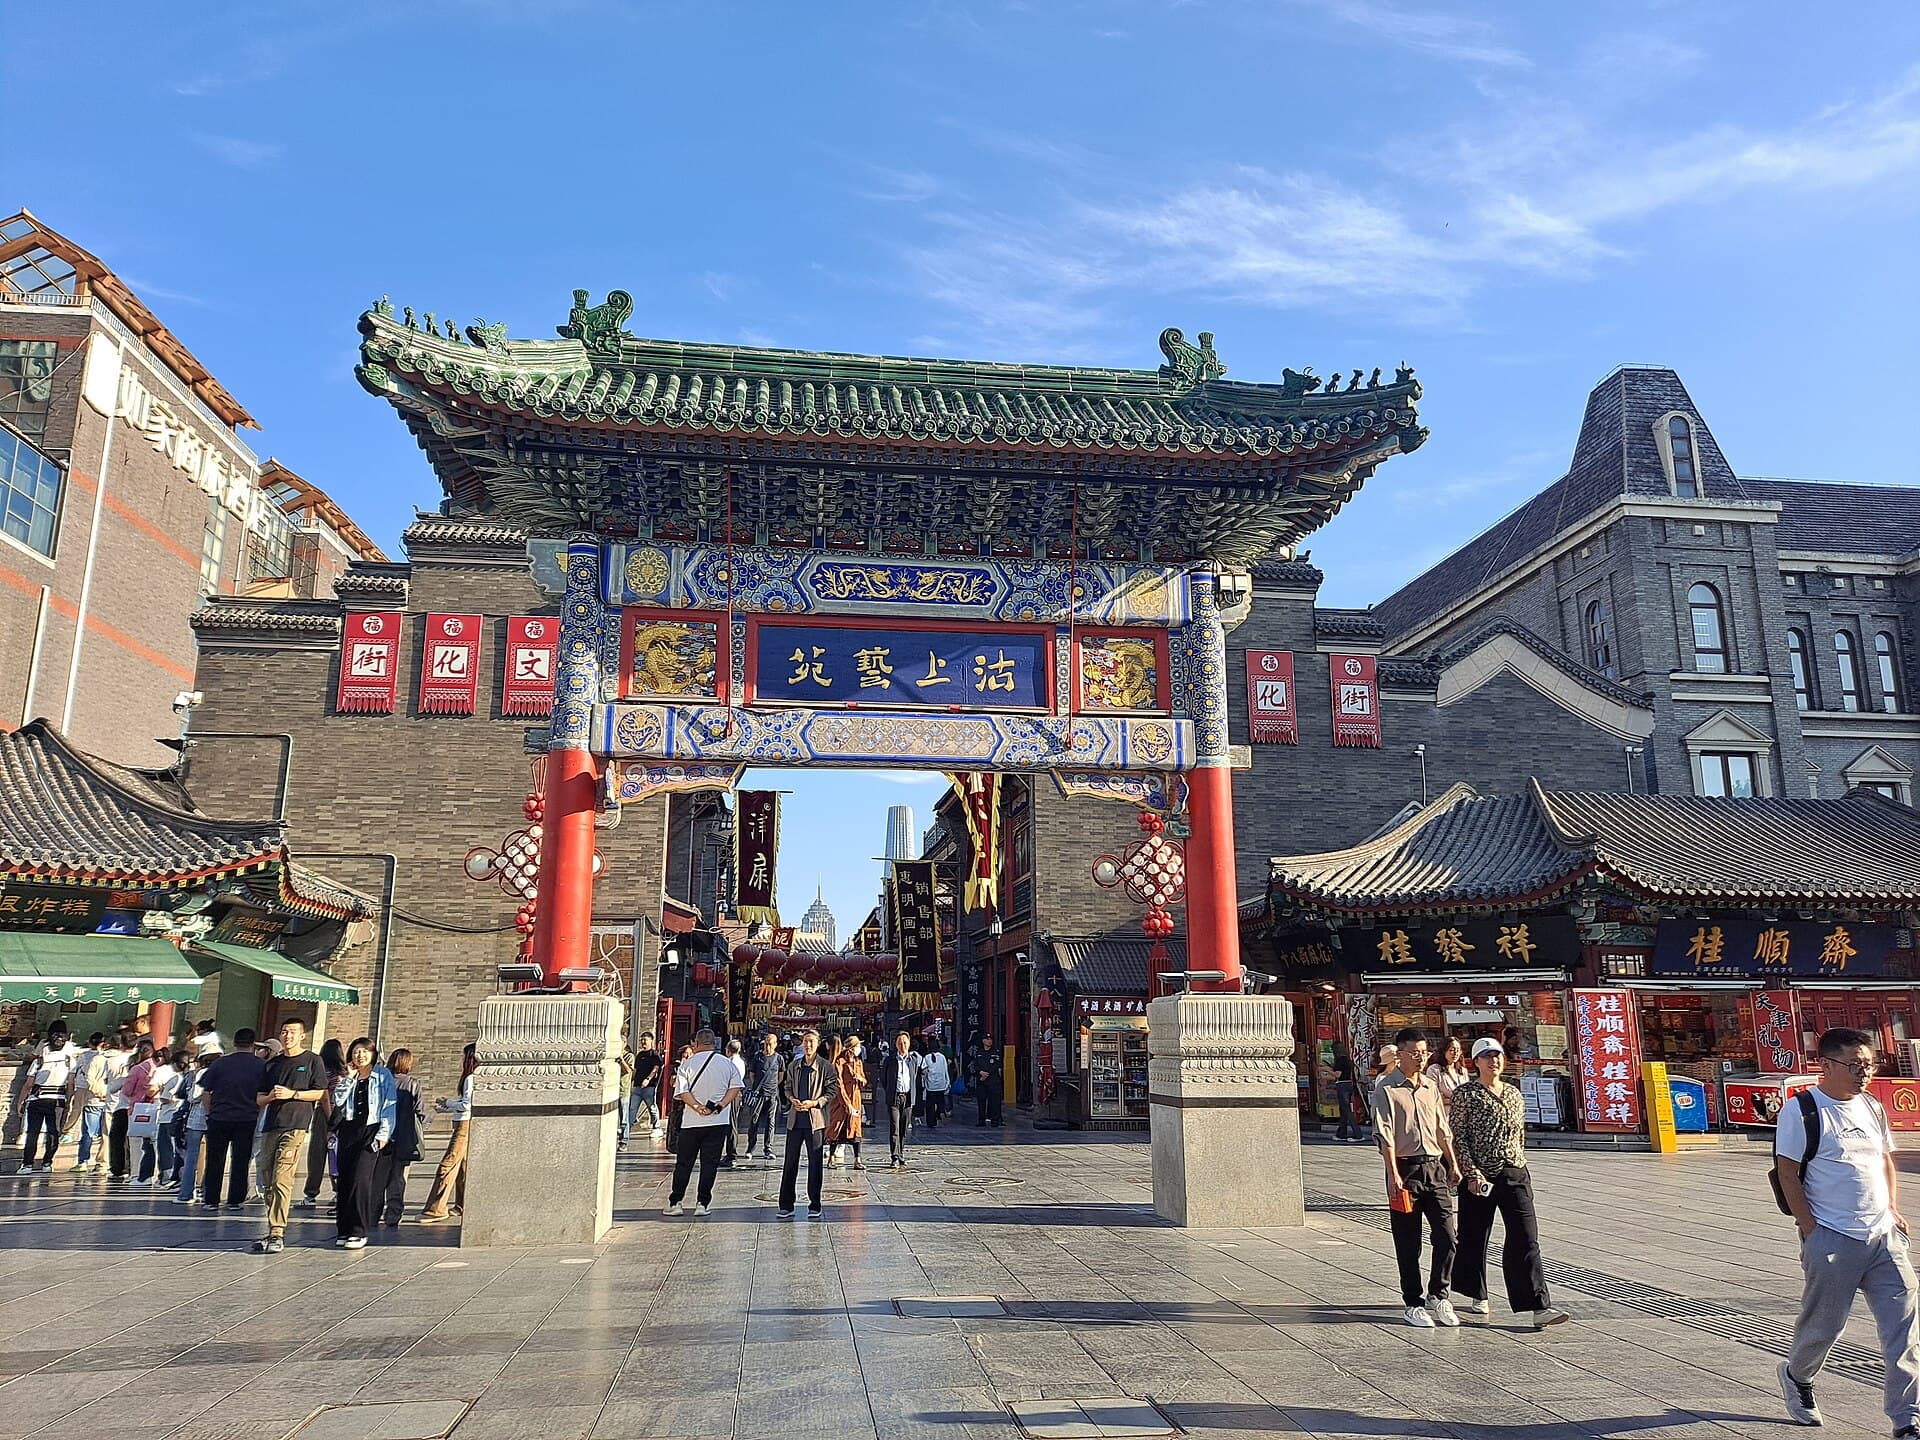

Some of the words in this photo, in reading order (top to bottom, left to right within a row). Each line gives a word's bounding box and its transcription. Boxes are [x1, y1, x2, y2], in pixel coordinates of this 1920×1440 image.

[364, 617, 382, 633] 福
[446, 619, 462, 635] 福
[526, 622, 544, 638] 福
[354, 650, 387, 674] 街
[434, 650, 465, 675] 化
[517, 651, 547, 678] 文
[1262, 656, 1277, 670] 福
[1346, 660, 1360, 674] 福
[1258, 684, 1285, 708] 化
[1342, 687, 1368, 712] 街
[914, 881, 933, 940] 销售部
[45, 986, 141, 998] 天津三绝
[1756, 992, 1794, 1070] 天津礼物
